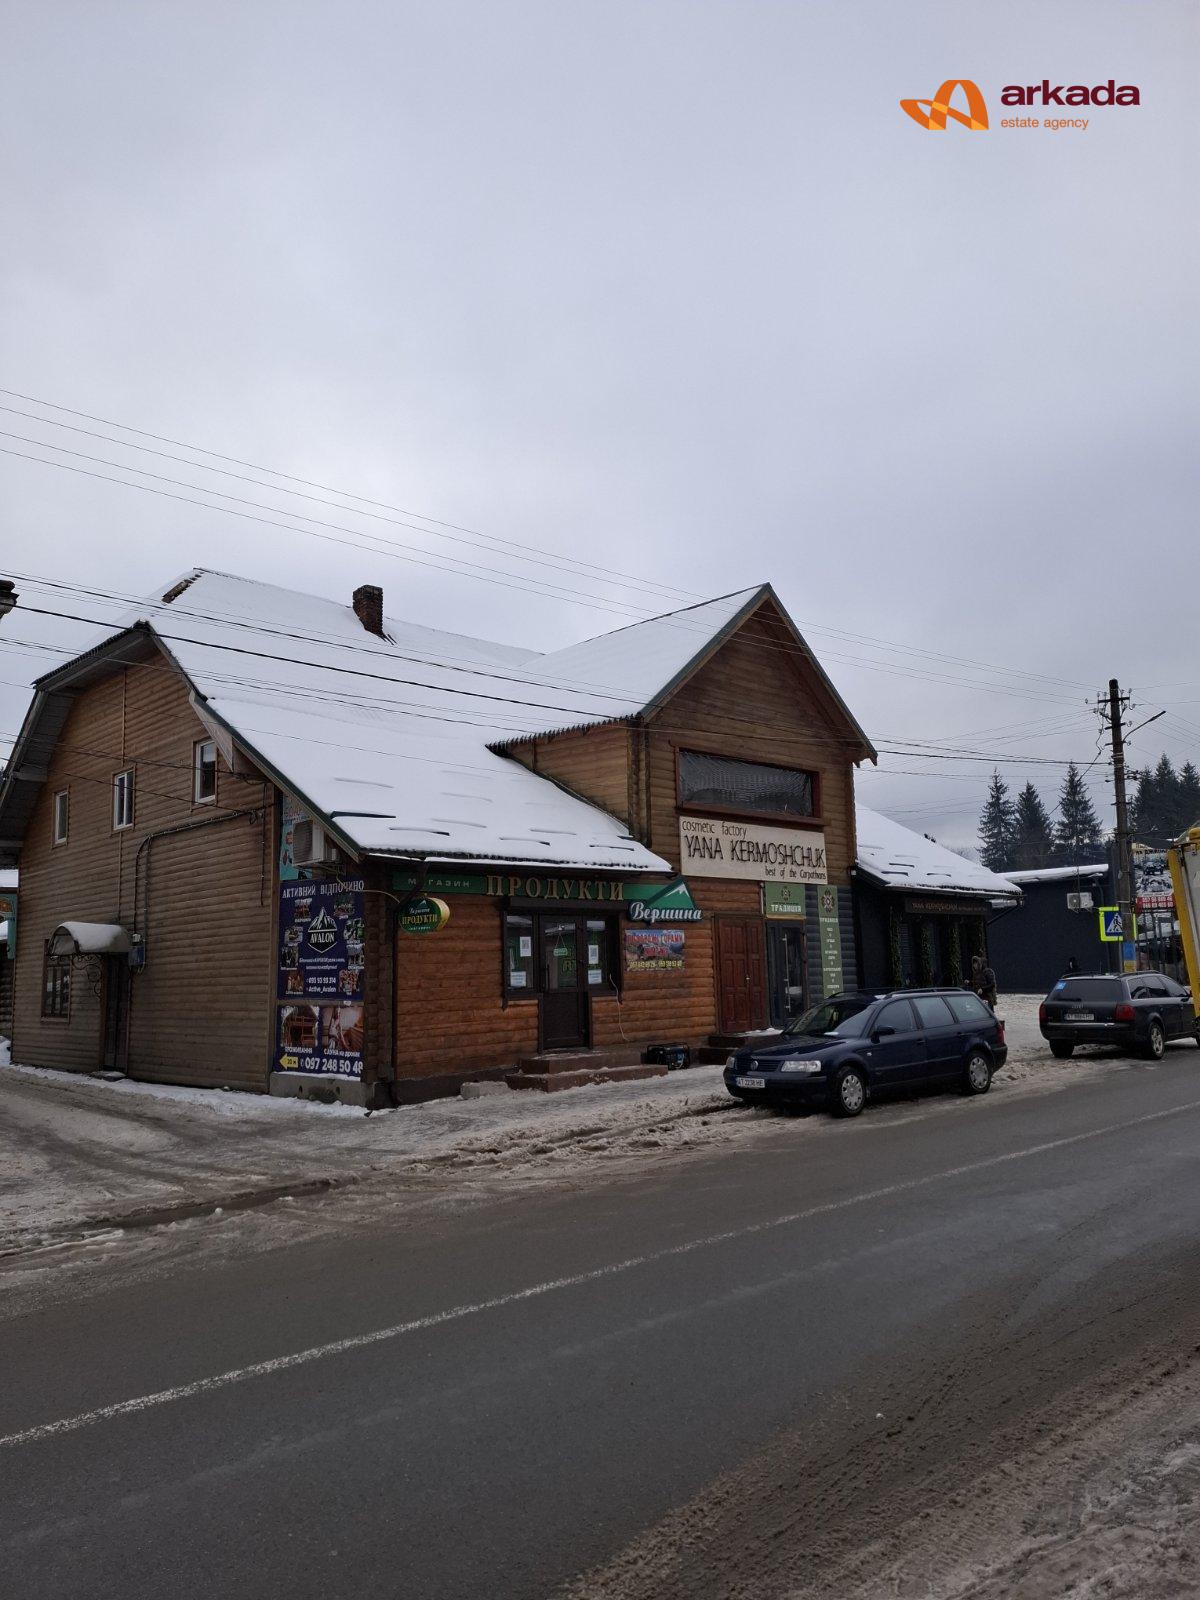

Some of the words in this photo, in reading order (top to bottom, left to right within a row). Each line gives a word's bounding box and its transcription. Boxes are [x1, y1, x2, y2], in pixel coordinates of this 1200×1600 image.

[682, 820, 715, 834] cosmetic
[721, 821, 747, 837] factory
[684, 835, 724, 860] YANA
[730, 839, 826, 868] KERMOSHCHUK
[765, 866, 776, 877] best
[780, 867, 786, 879] of
[408, 878, 470, 887] МГАЗИН
[486, 875, 624, 901] ПРОДУКТИ
[282, 884, 316, 898] АКТИВНИЙ
[630, 901, 702, 923] Вершина
[310, 932, 335, 943] AVALON
[305, 1057, 320, 1070] 097
[322, 1058, 337, 1071] 248
[339, 1060, 350, 1073] 50
